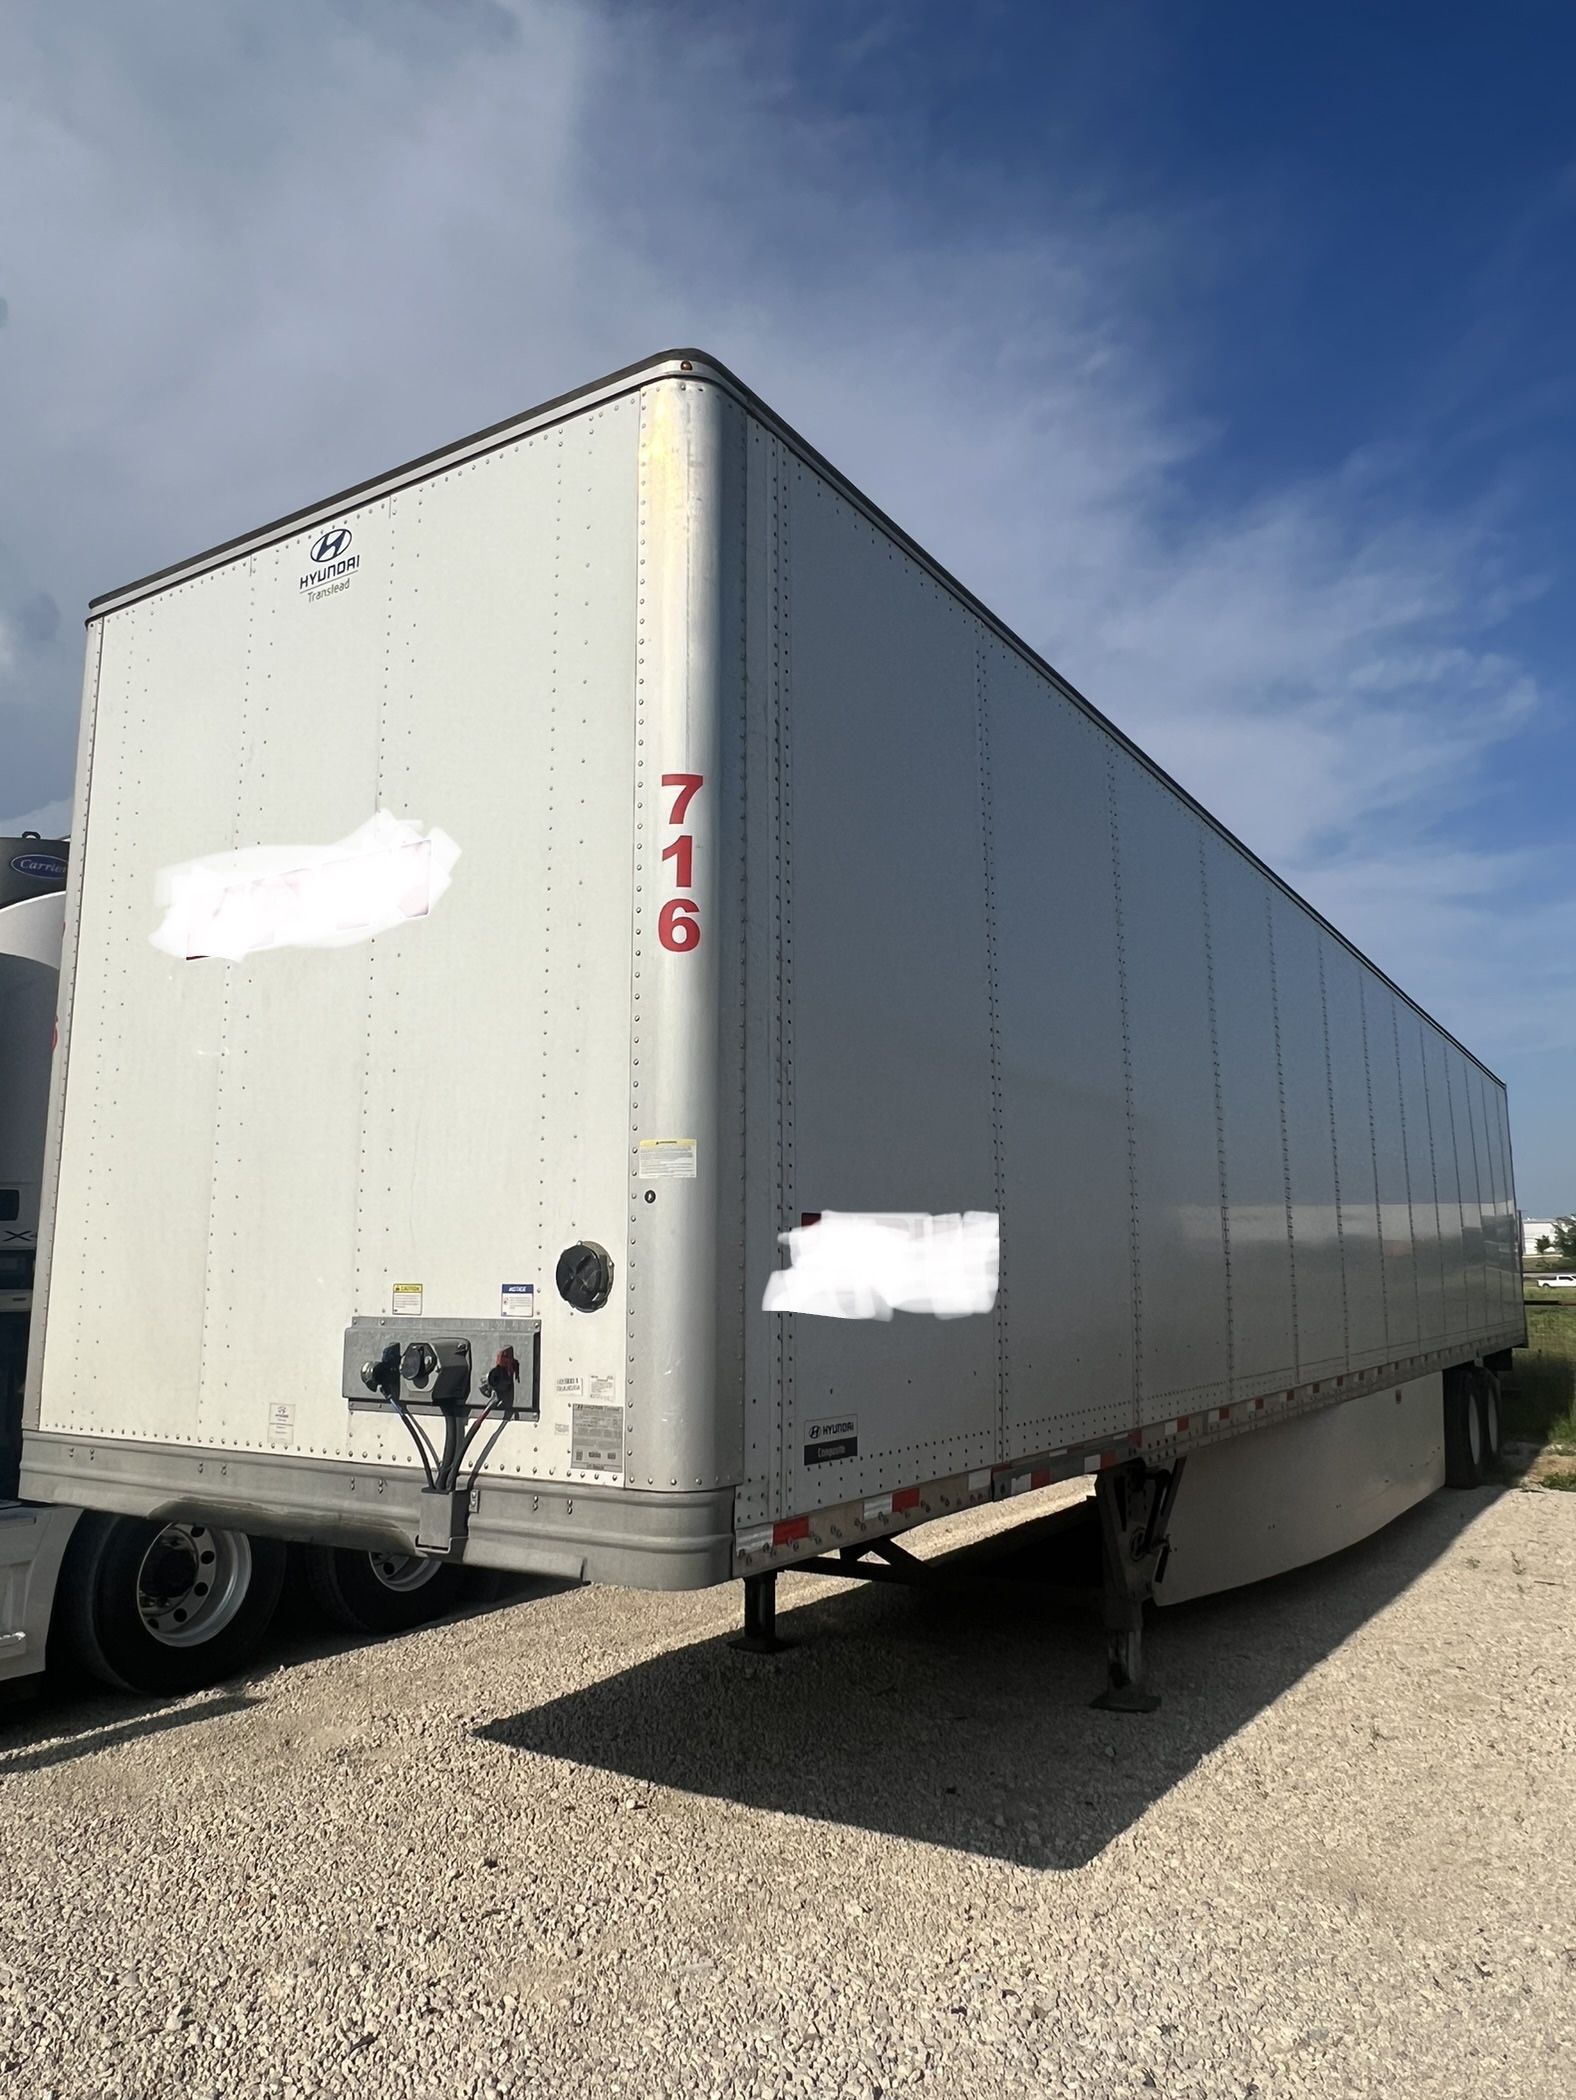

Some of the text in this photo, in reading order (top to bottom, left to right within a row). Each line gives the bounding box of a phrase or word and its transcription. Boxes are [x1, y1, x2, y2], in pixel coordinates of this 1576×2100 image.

[299, 554, 360, 590] HYUNDAI
[307, 577, 351, 603] Translead
[658, 773, 704, 953] 716
[2, 1230, 37, 1242] X
[822, 1422, 855, 1436] HYUNDAI
